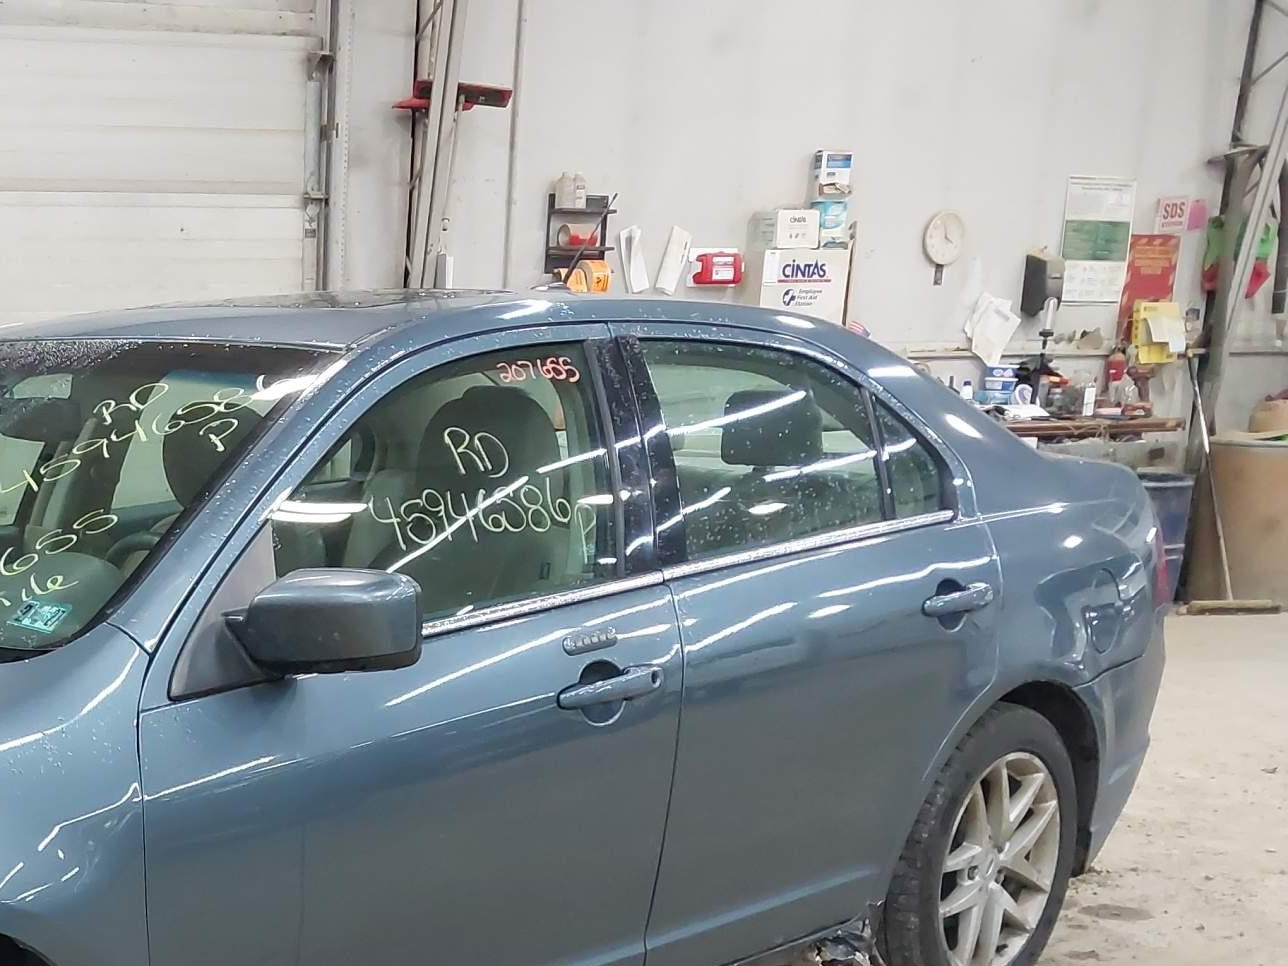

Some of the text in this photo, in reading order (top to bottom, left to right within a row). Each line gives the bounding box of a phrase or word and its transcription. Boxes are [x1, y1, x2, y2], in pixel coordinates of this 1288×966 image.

[1163, 201, 1186, 220] SDS
[496, 356, 581, 383] 207655
[443, 426, 510, 478] RD
[367, 476, 572, 551] 45946586
